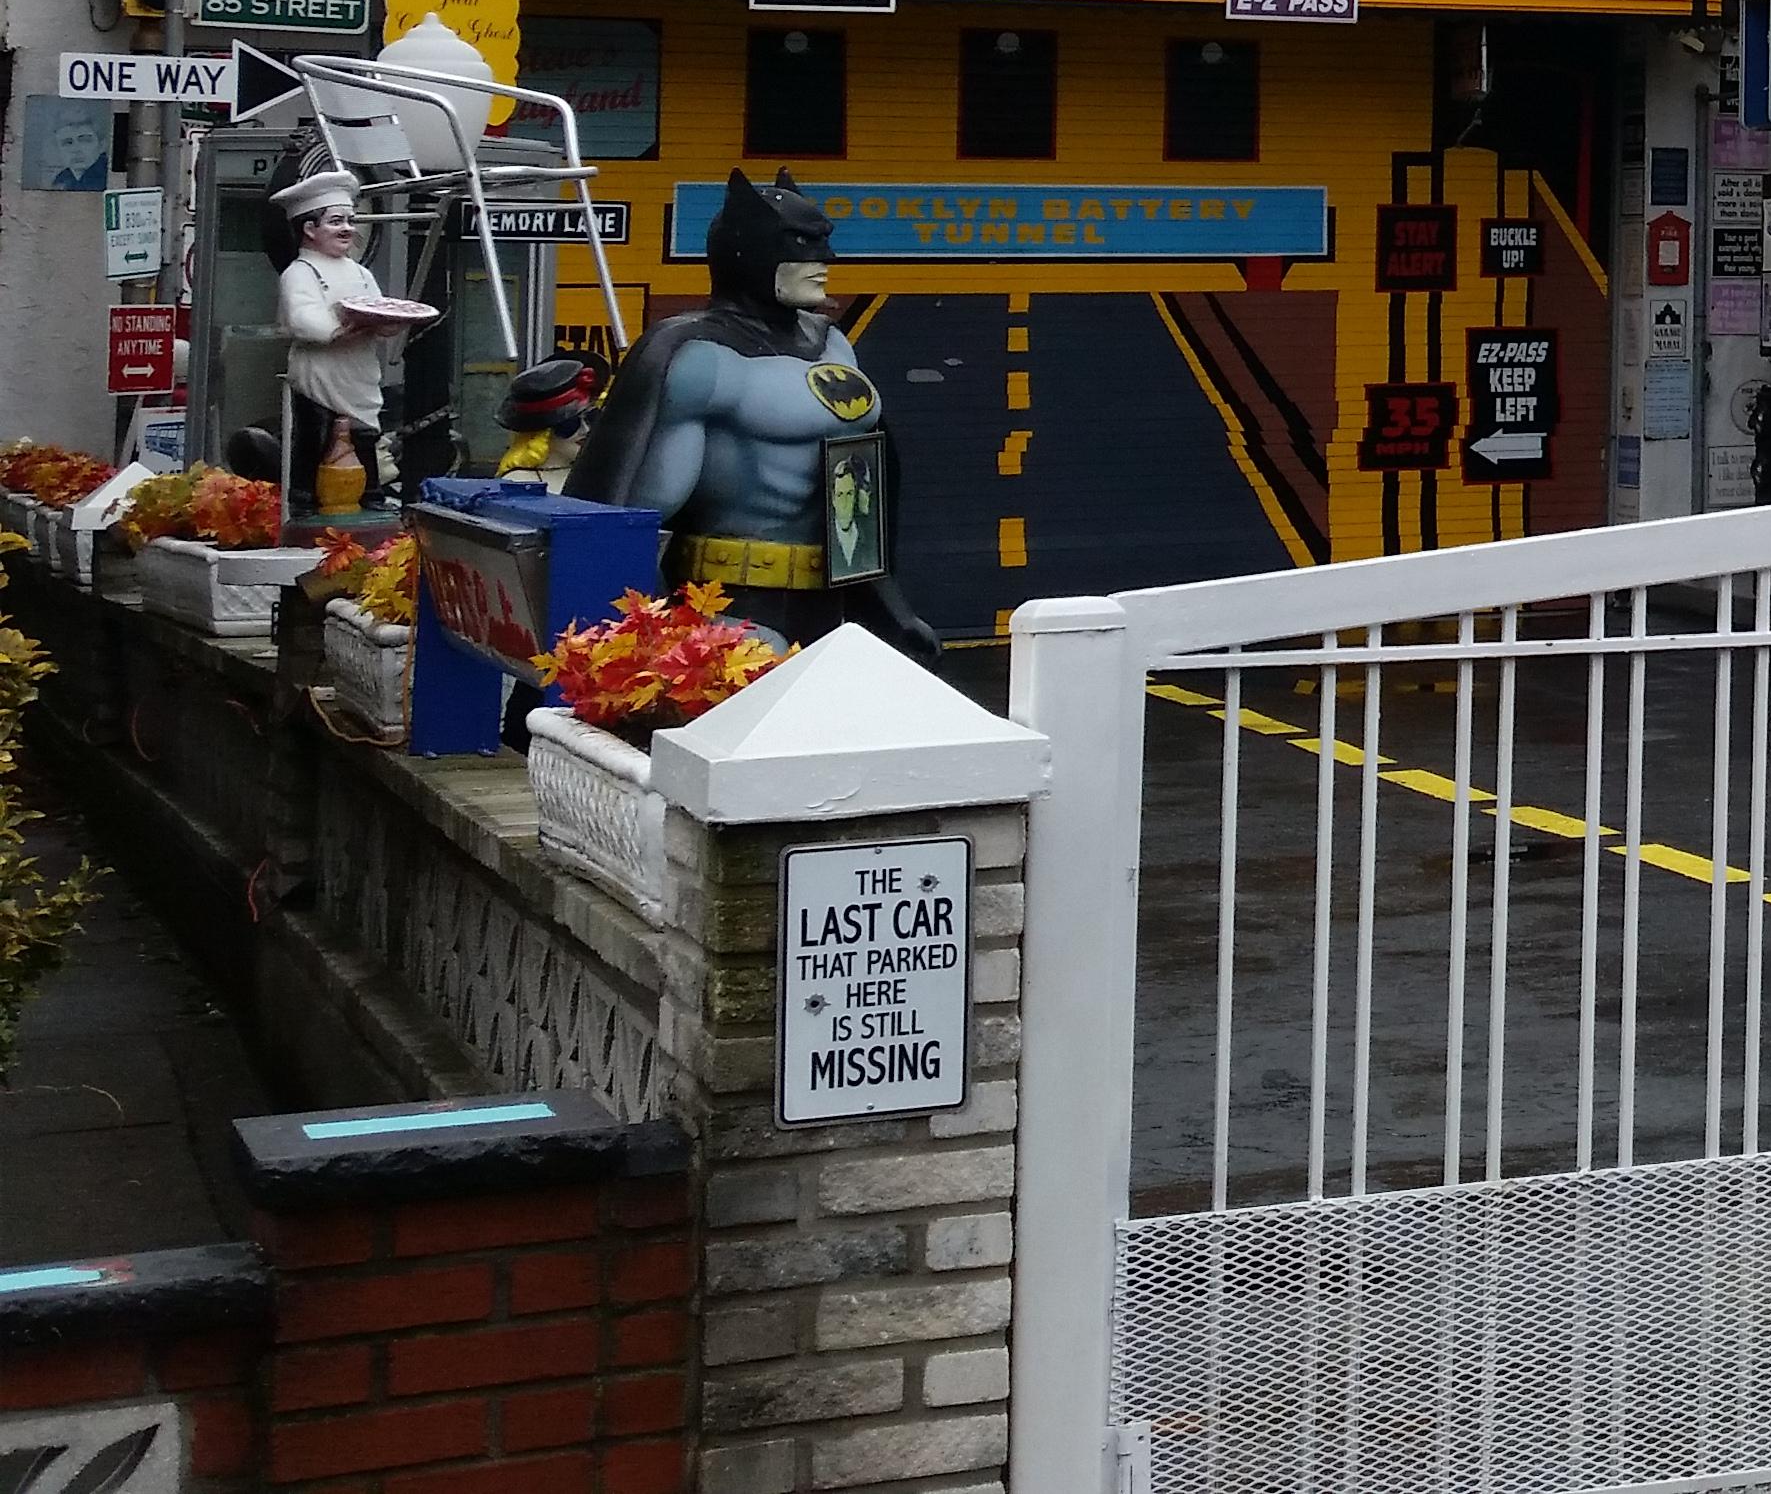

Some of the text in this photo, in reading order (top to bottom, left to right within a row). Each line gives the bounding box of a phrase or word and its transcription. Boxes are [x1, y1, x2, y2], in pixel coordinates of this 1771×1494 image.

[68, 60, 226, 95] ONE WAY
[820, 196, 1257, 221] OOKLYN BATTERY
[914, 222, 1105, 245] TUNNEL
[1394, 221, 1440, 246] STAY
[1490, 227, 1537, 247] BUCKLE
[1387, 253, 1446, 276] ALERT
[1502, 250, 1524, 268] UP!
[112, 315, 171, 333] NO STANDING
[117, 338, 164, 356] ANYTIME
[1477, 342, 1549, 363] EZ-PASS
[1490, 367, 1536, 393] KEEP
[1382, 397, 1440, 438] 35
[1496, 397, 1537, 422] LEFT
[1376, 442, 1430, 455] MPH
[855, 867, 902, 895] THE
[801, 897, 953, 947] LAST CAR
[797, 943, 958, 981] THAT PARKED
[846, 978, 907, 1009] HERE
[832, 1009, 924, 1042] IS STILL
[810, 1040, 940, 1090] MISSING
